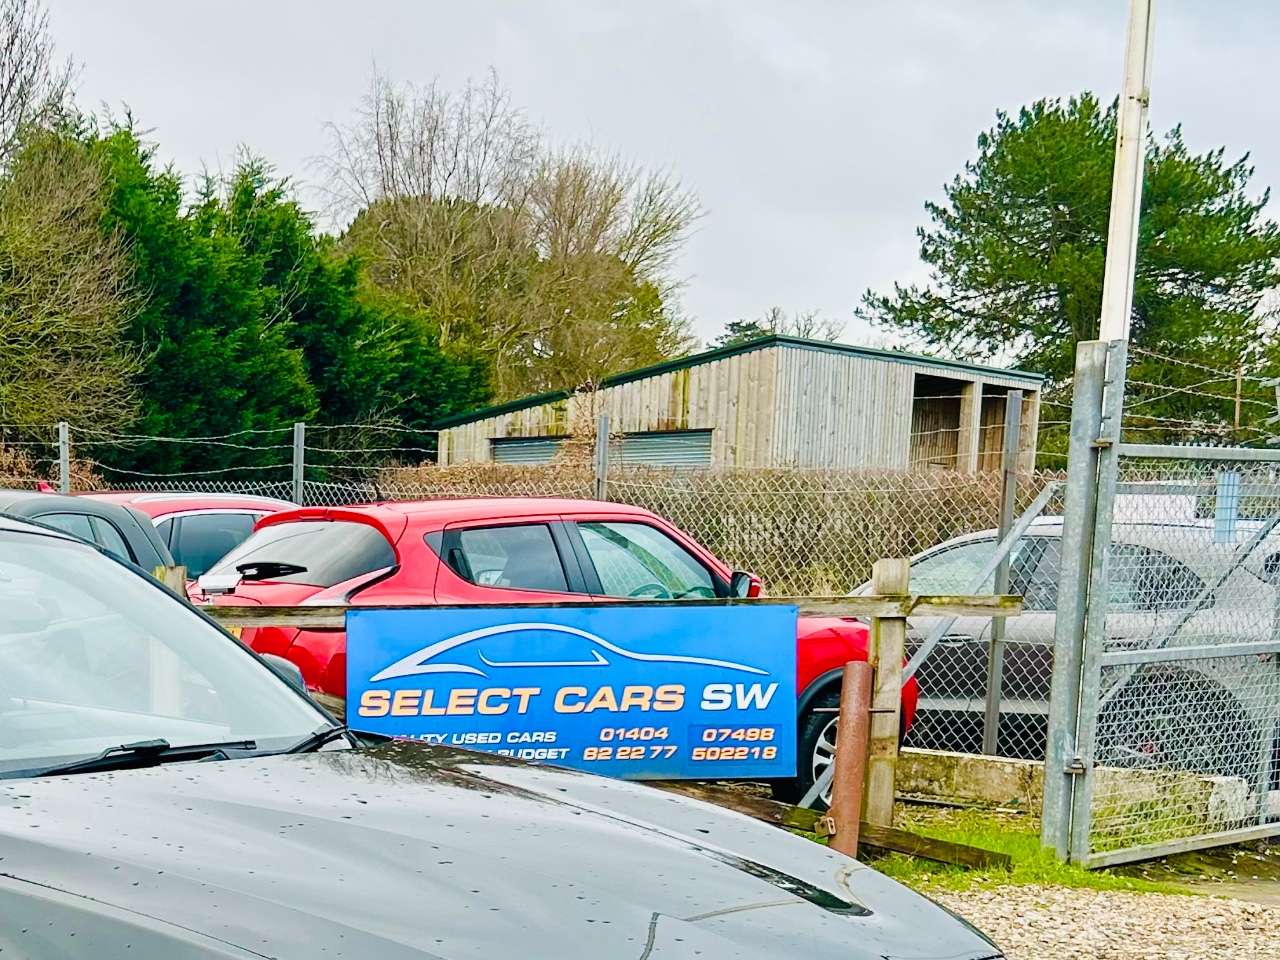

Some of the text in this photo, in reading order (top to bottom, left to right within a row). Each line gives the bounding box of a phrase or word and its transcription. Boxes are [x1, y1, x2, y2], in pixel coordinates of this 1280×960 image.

[357, 682, 779, 717] SELECT CARS SW
[451, 732, 502, 745] USED
[506, 731, 557, 743] CARS
[599, 727, 669, 741] 01404
[583, 745, 678, 761] 82 22 77
[691, 746, 777, 761] 502218
